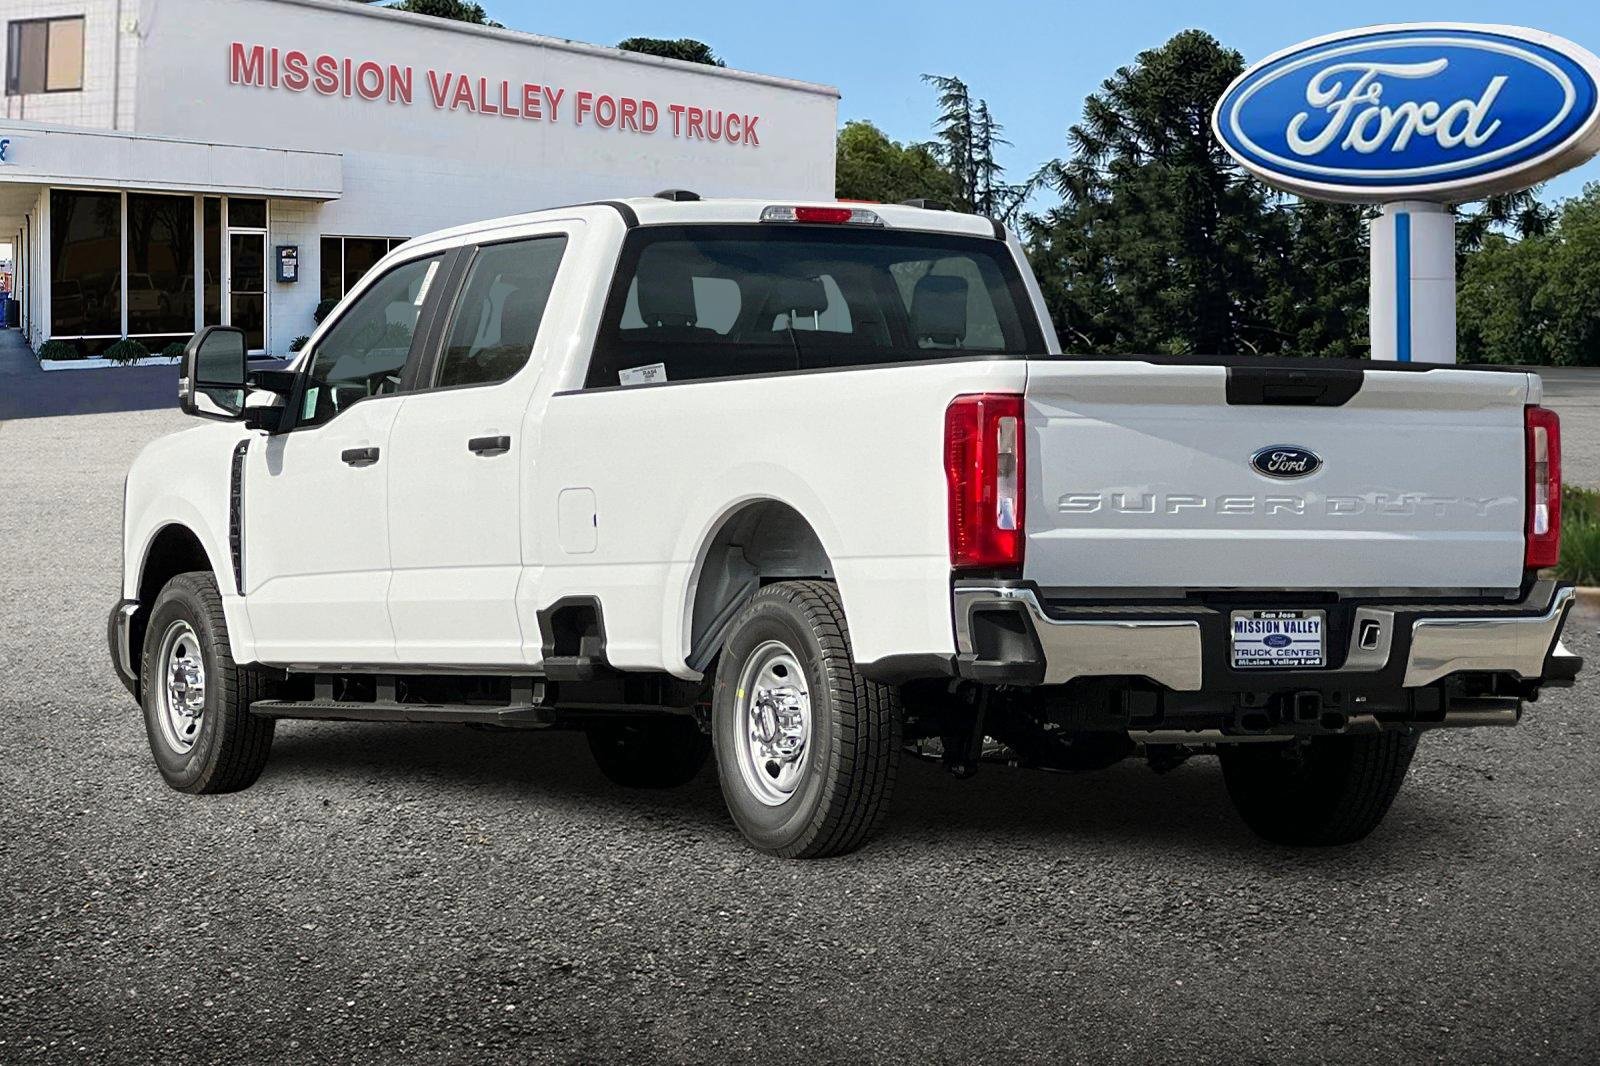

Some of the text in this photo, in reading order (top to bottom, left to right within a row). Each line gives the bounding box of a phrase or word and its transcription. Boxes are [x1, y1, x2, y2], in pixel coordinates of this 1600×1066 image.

[230, 42, 761, 146] MISSION VALLEY FORD TRUCK
[1286, 57, 1509, 156] Ford
[1267, 451, 1308, 472] Ford
[1057, 493, 1519, 516] SUPER DUTY
[1260, 611, 1296, 619] San Jose
[1234, 620, 1320, 634] MISSION VALLEY
[1235, 649, 1320, 657] TRUCK CENTER
[1272, 659, 1299, 667] Valley
